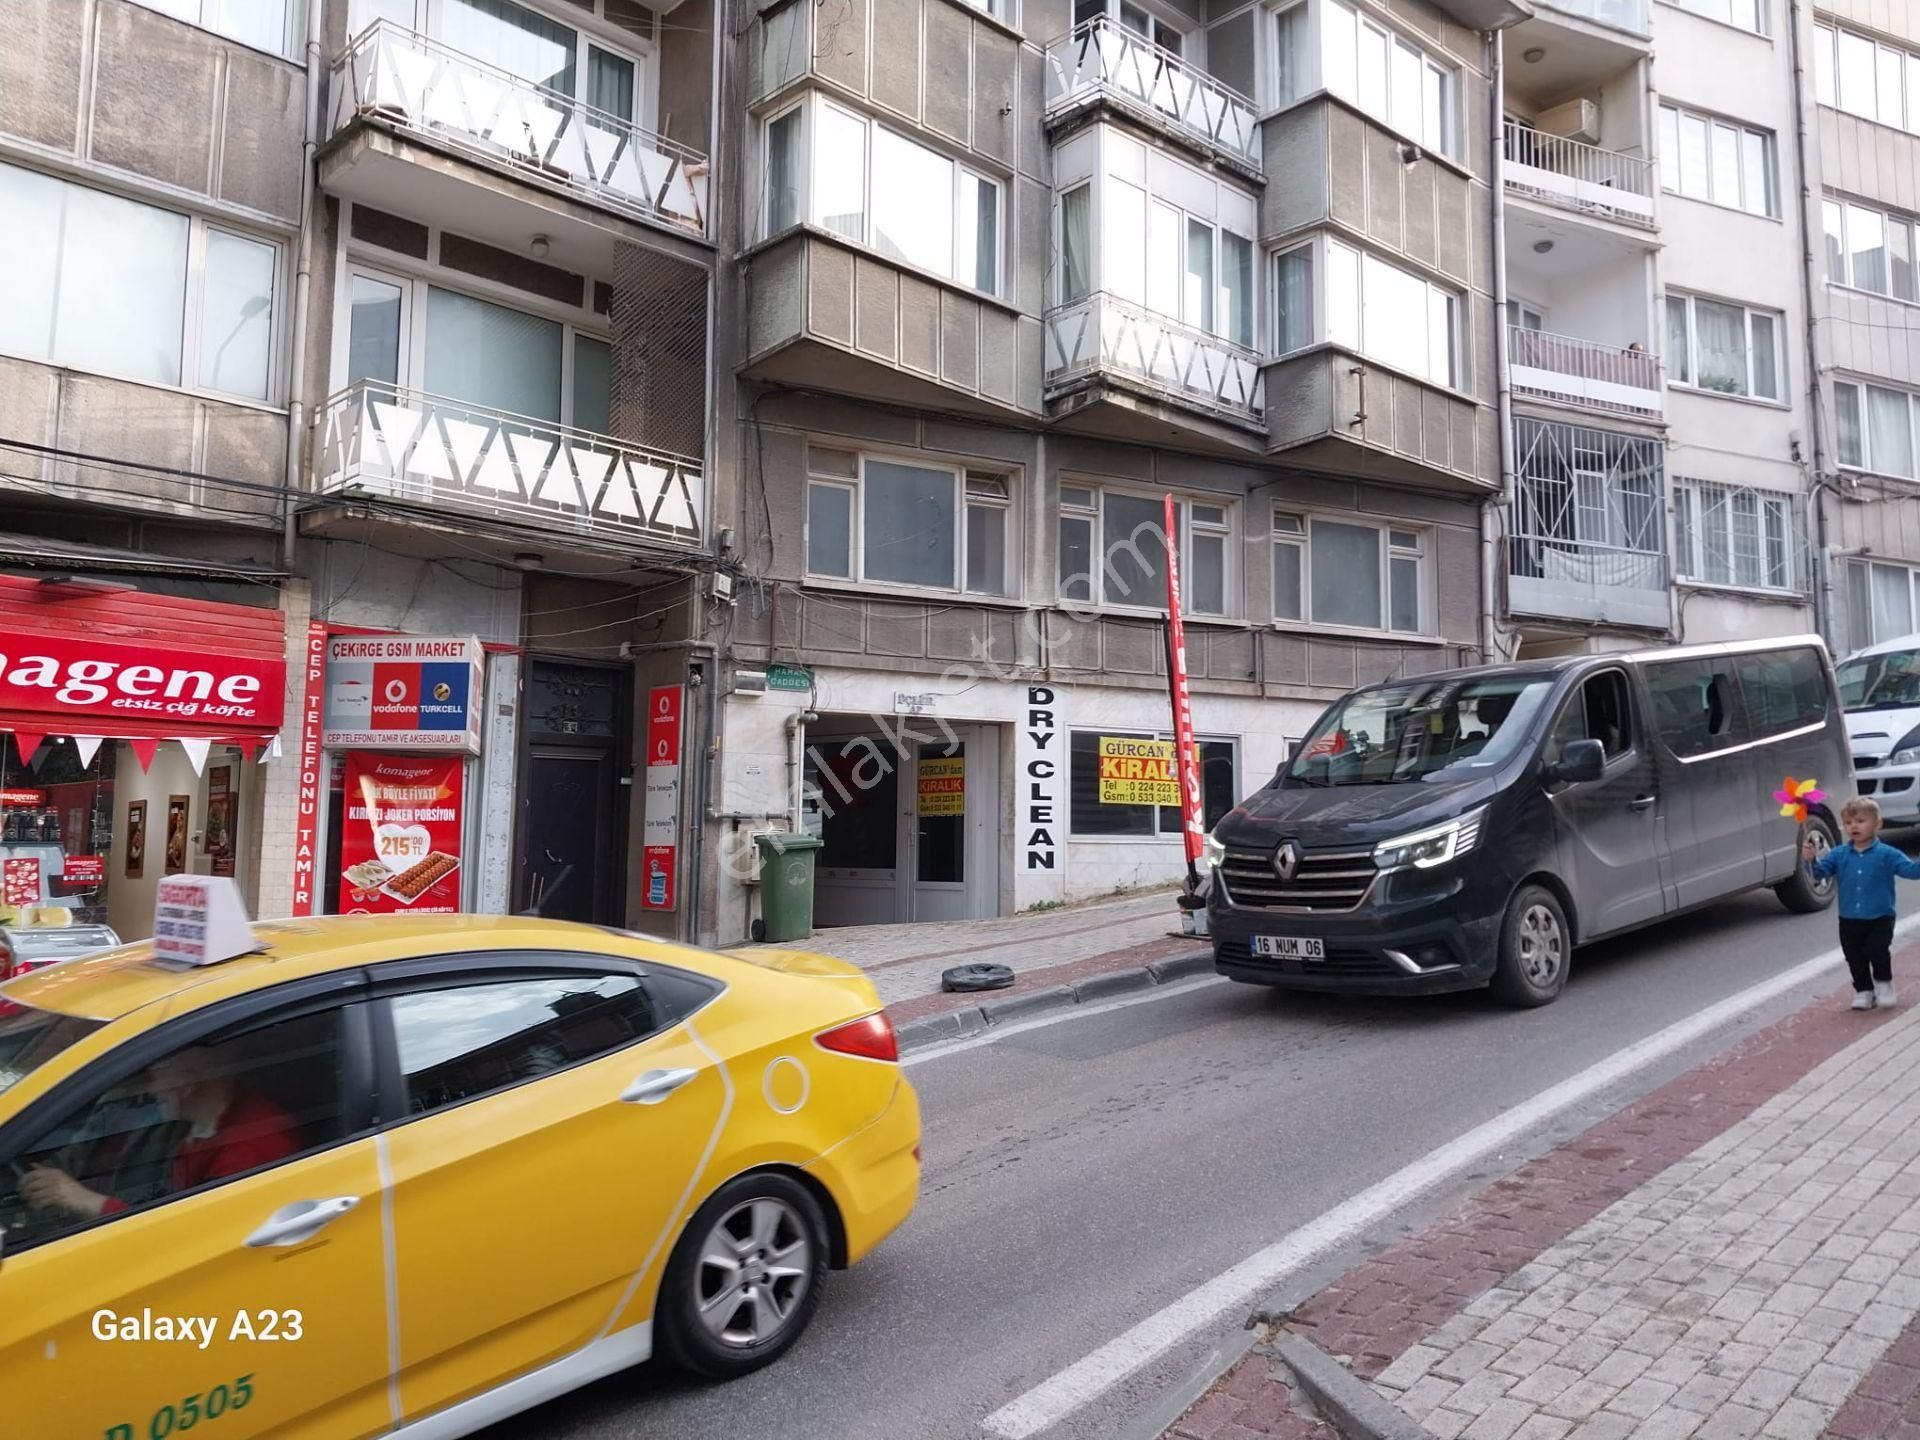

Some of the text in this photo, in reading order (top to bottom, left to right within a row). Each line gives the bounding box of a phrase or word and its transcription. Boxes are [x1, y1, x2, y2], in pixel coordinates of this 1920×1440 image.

[387, 643, 412, 657] GSM
[415, 642, 466, 657] MARKET
[309, 639, 322, 681] CEP
[112, 697, 256, 718] etsiz çiğ köfte
[373, 704, 417, 713] vodafone
[328, 733, 341, 743] CEP
[300, 695, 319, 815] TELEFONU
[376, 763, 433, 779] komagene
[1027, 687, 1054, 870] DRY CLEAN
[1104, 780, 1117, 790] Tel
[1138, 782, 1154, 791] 224
[1157, 782, 1171, 792] 223
[1138, 792, 1154, 802] 533
[1157, 794, 1171, 803] 340
[384, 807, 413, 821] JOKER
[381, 836, 410, 856] 215
[413, 846, 423, 855] TL
[1257, 937, 1321, 955] 16 NUM 06
